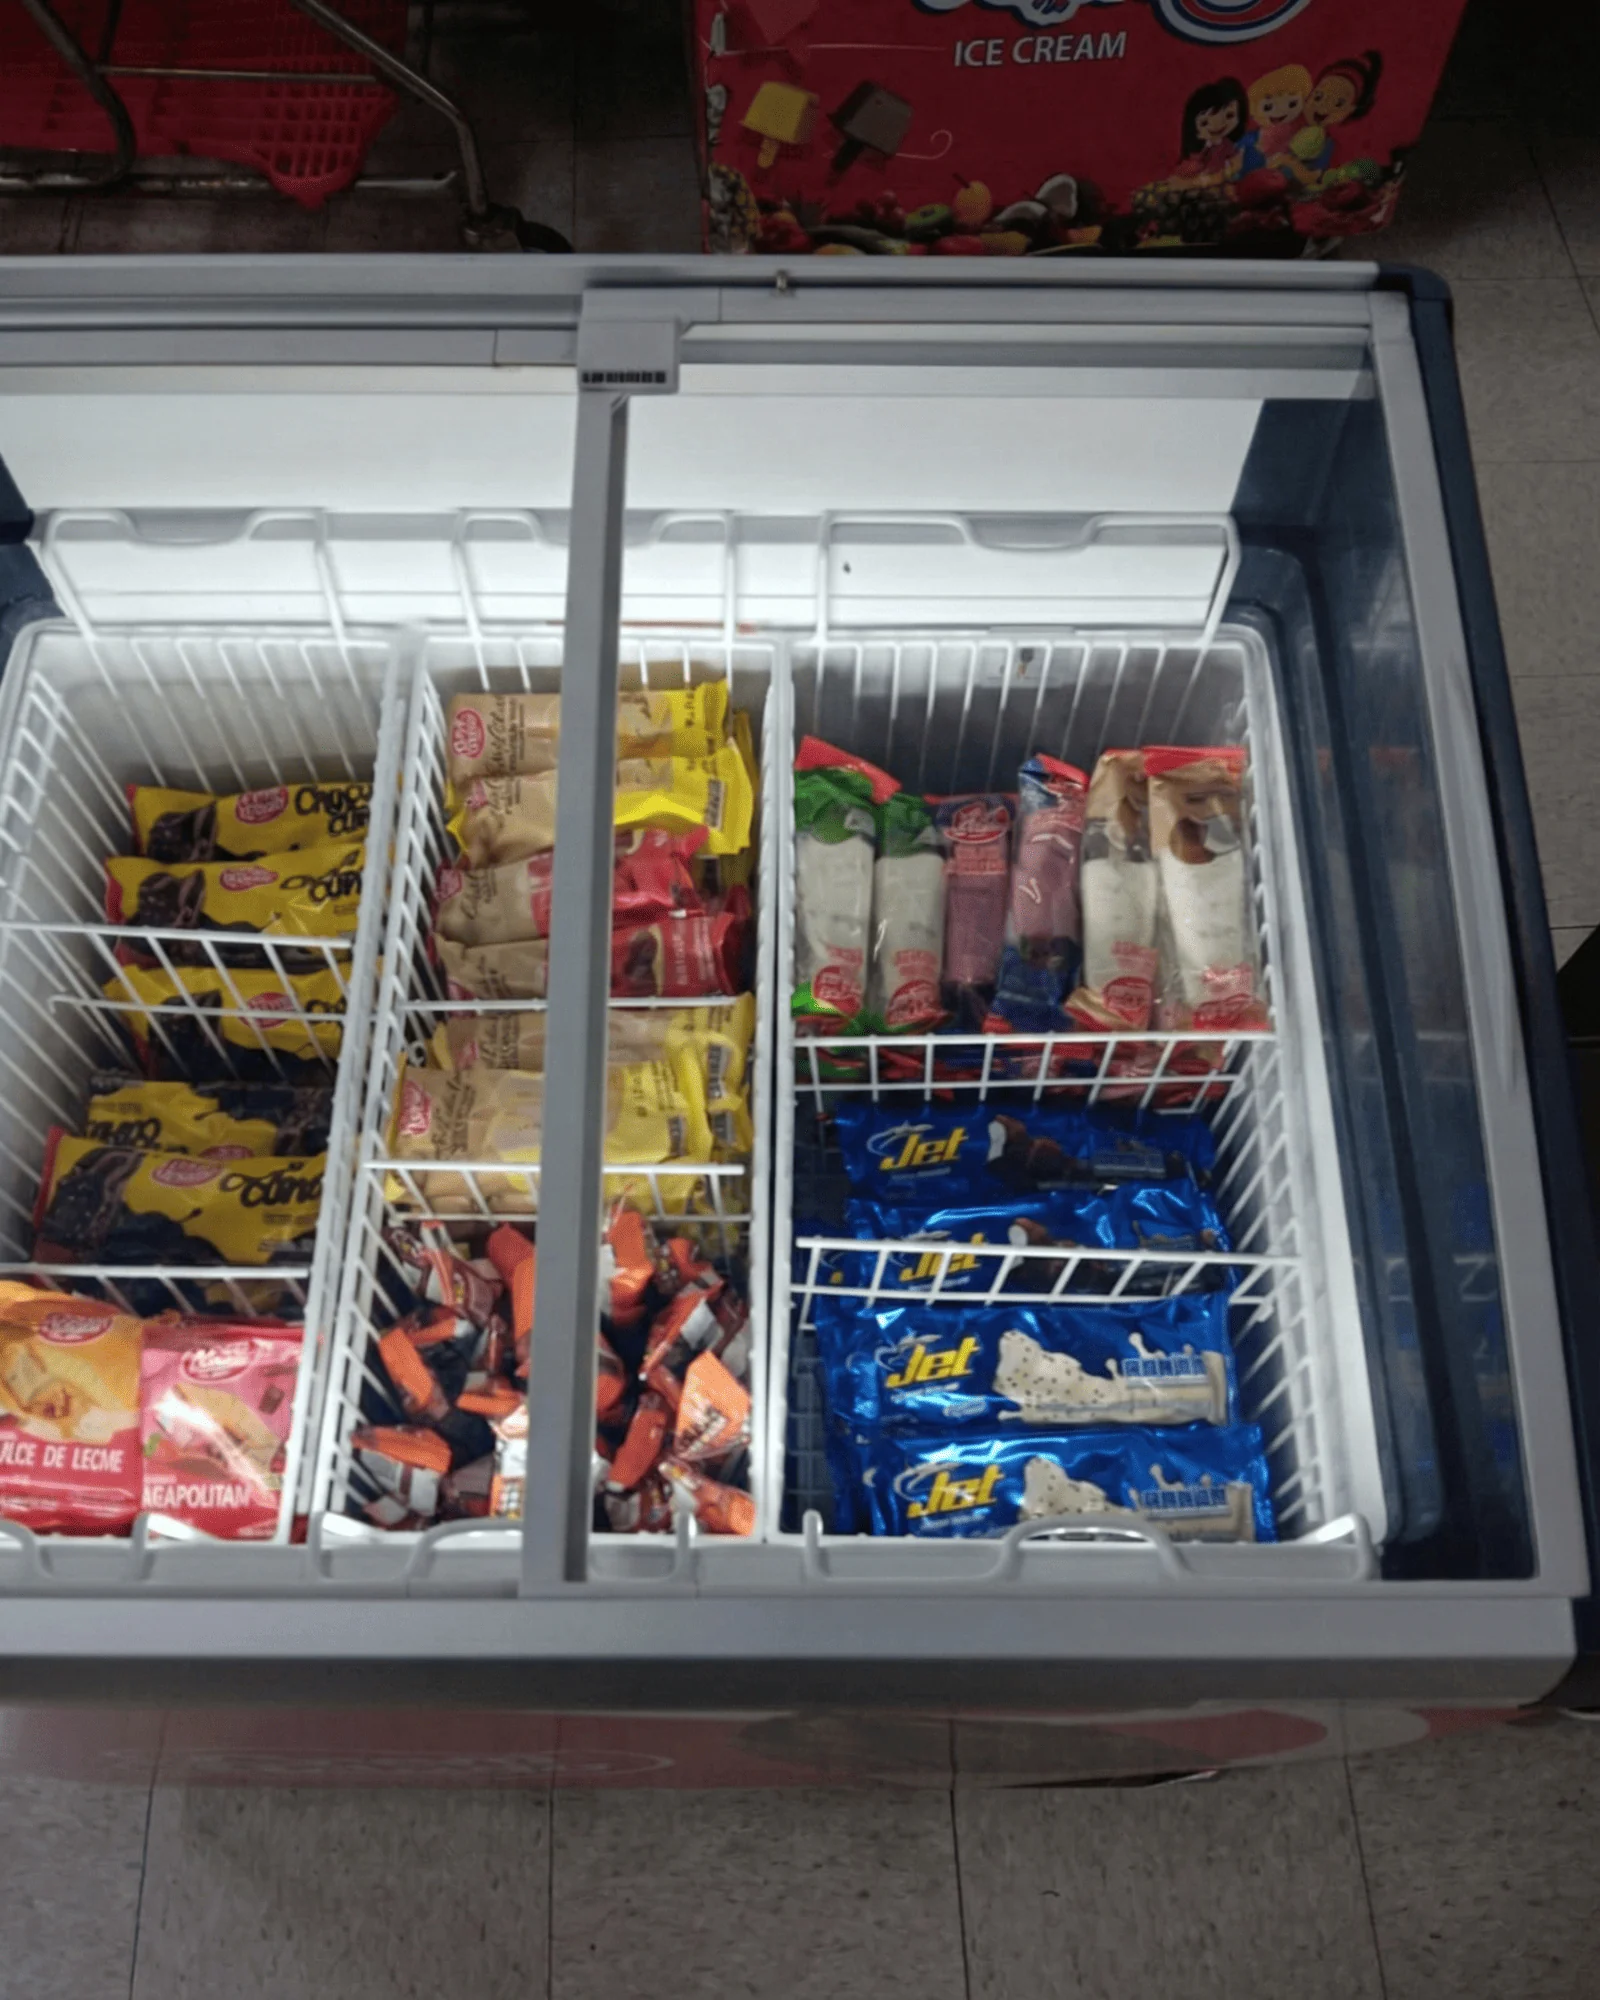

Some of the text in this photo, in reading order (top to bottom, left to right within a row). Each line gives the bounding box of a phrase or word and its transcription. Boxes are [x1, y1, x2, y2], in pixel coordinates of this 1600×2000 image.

[953, 31, 1127, 67] ICE CREAM
[878, 1126, 969, 1173] Jet
[884, 1336, 983, 1389] Jet
[42, 1445, 66, 1469] DE
[906, 1464, 1004, 1518] Jet
